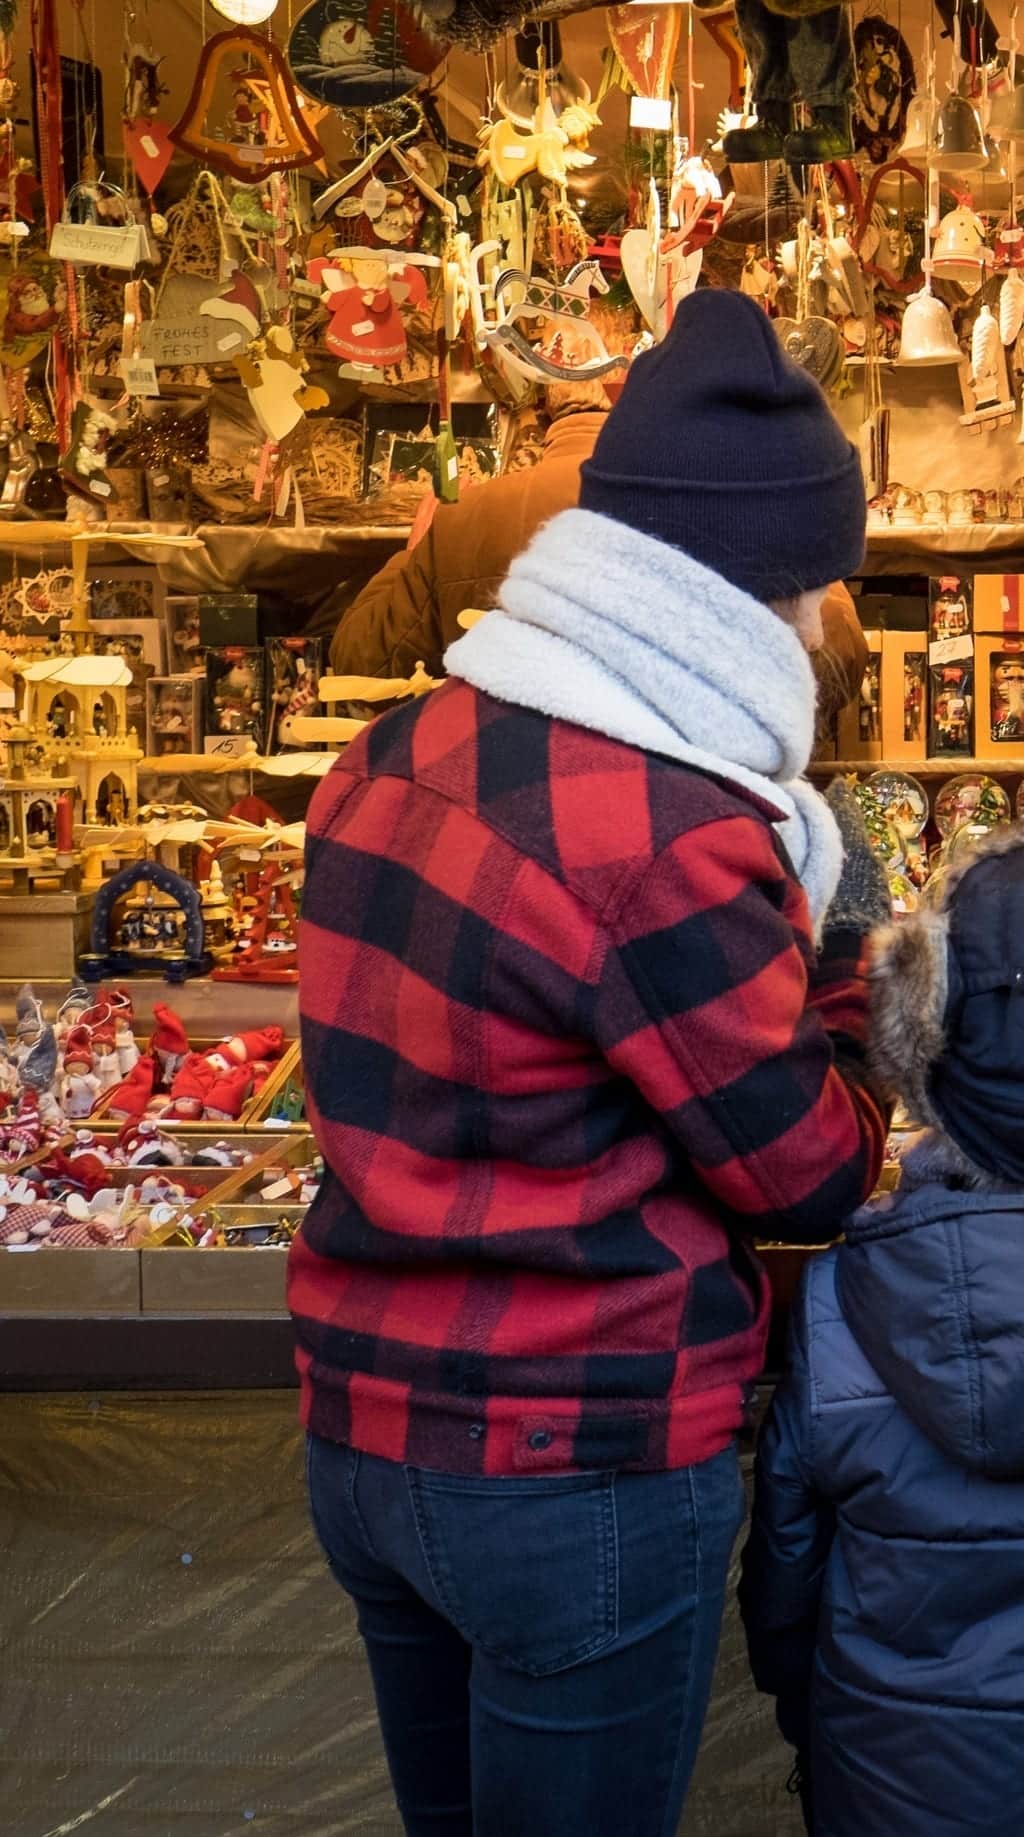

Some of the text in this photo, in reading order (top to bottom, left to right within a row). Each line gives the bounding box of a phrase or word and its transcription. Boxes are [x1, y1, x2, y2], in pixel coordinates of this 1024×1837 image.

[153, 326, 209, 340] FROHES
[162, 344, 204, 358] FEST
[211, 738, 239, 753] 15
